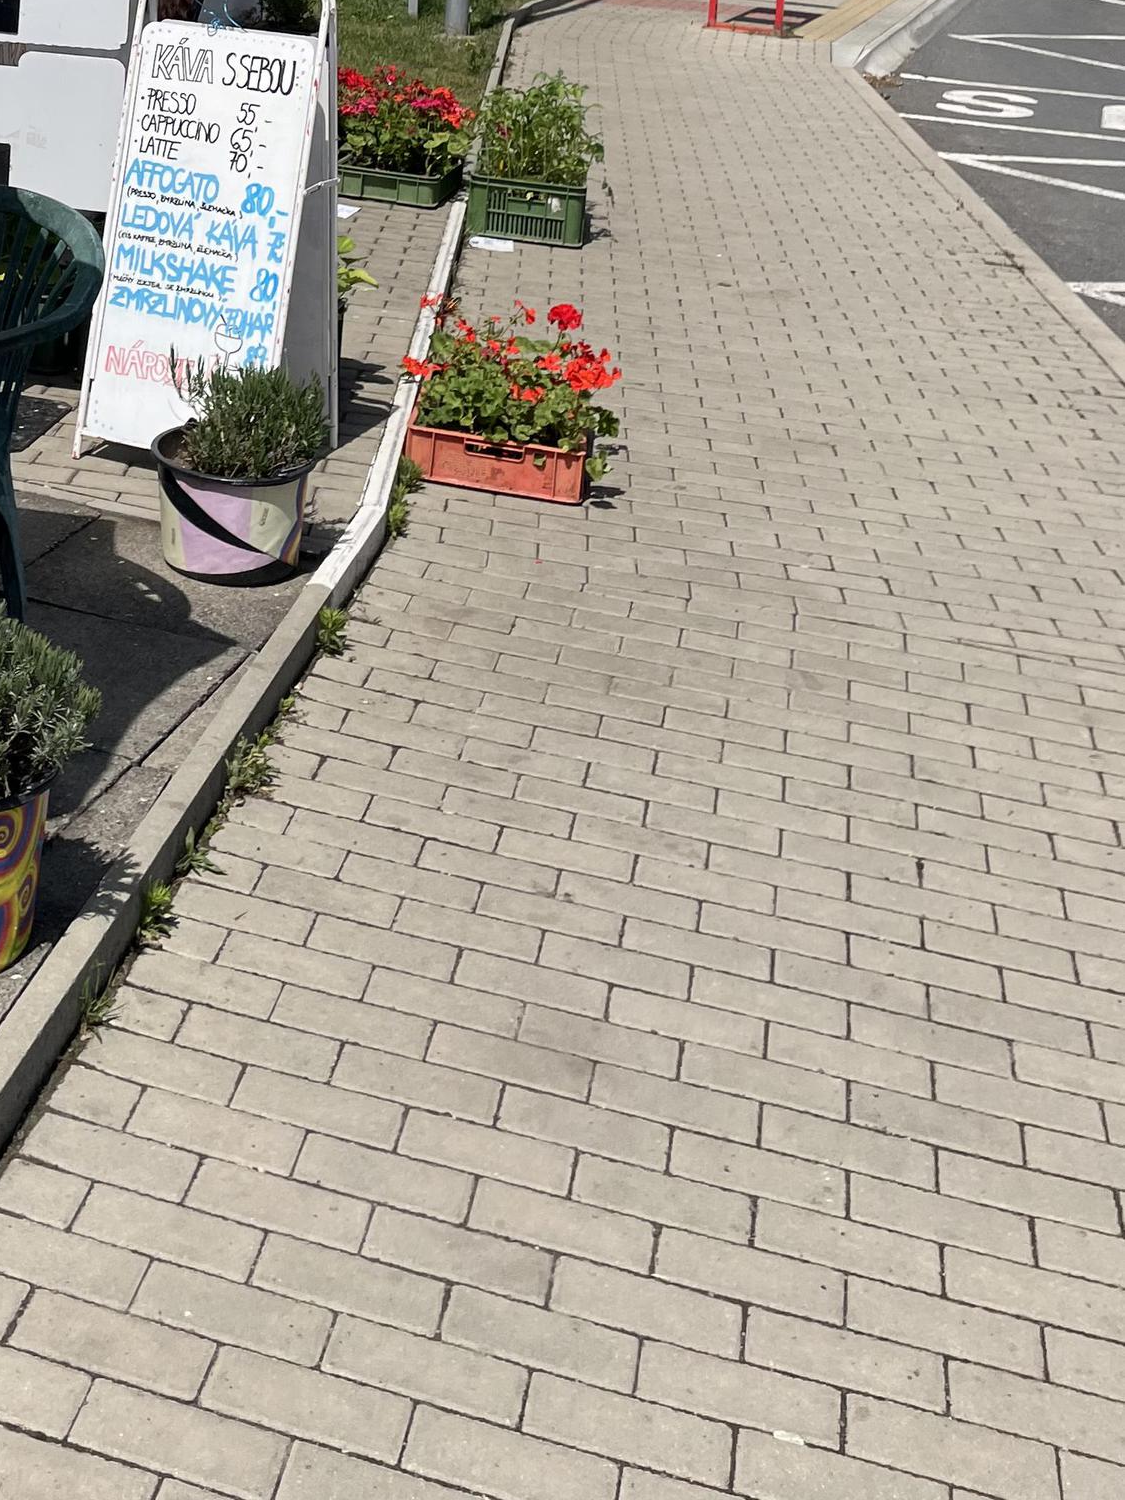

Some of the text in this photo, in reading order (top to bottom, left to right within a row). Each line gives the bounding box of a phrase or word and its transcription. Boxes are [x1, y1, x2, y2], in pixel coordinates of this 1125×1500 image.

[151, 38, 214, 84] KÁVA
[146, 87, 197, 116] PRESSO
[139, 136, 182, 161] LATTE
[141, 114, 221, 144] CAPPUCCINO
[125, 157, 220, 202] AFFOGATO
[121, 203, 202, 242] LEDOVÁ
[205, 218, 258, 260] KÁVA
[115, 243, 238, 295] MILKSHAKE
